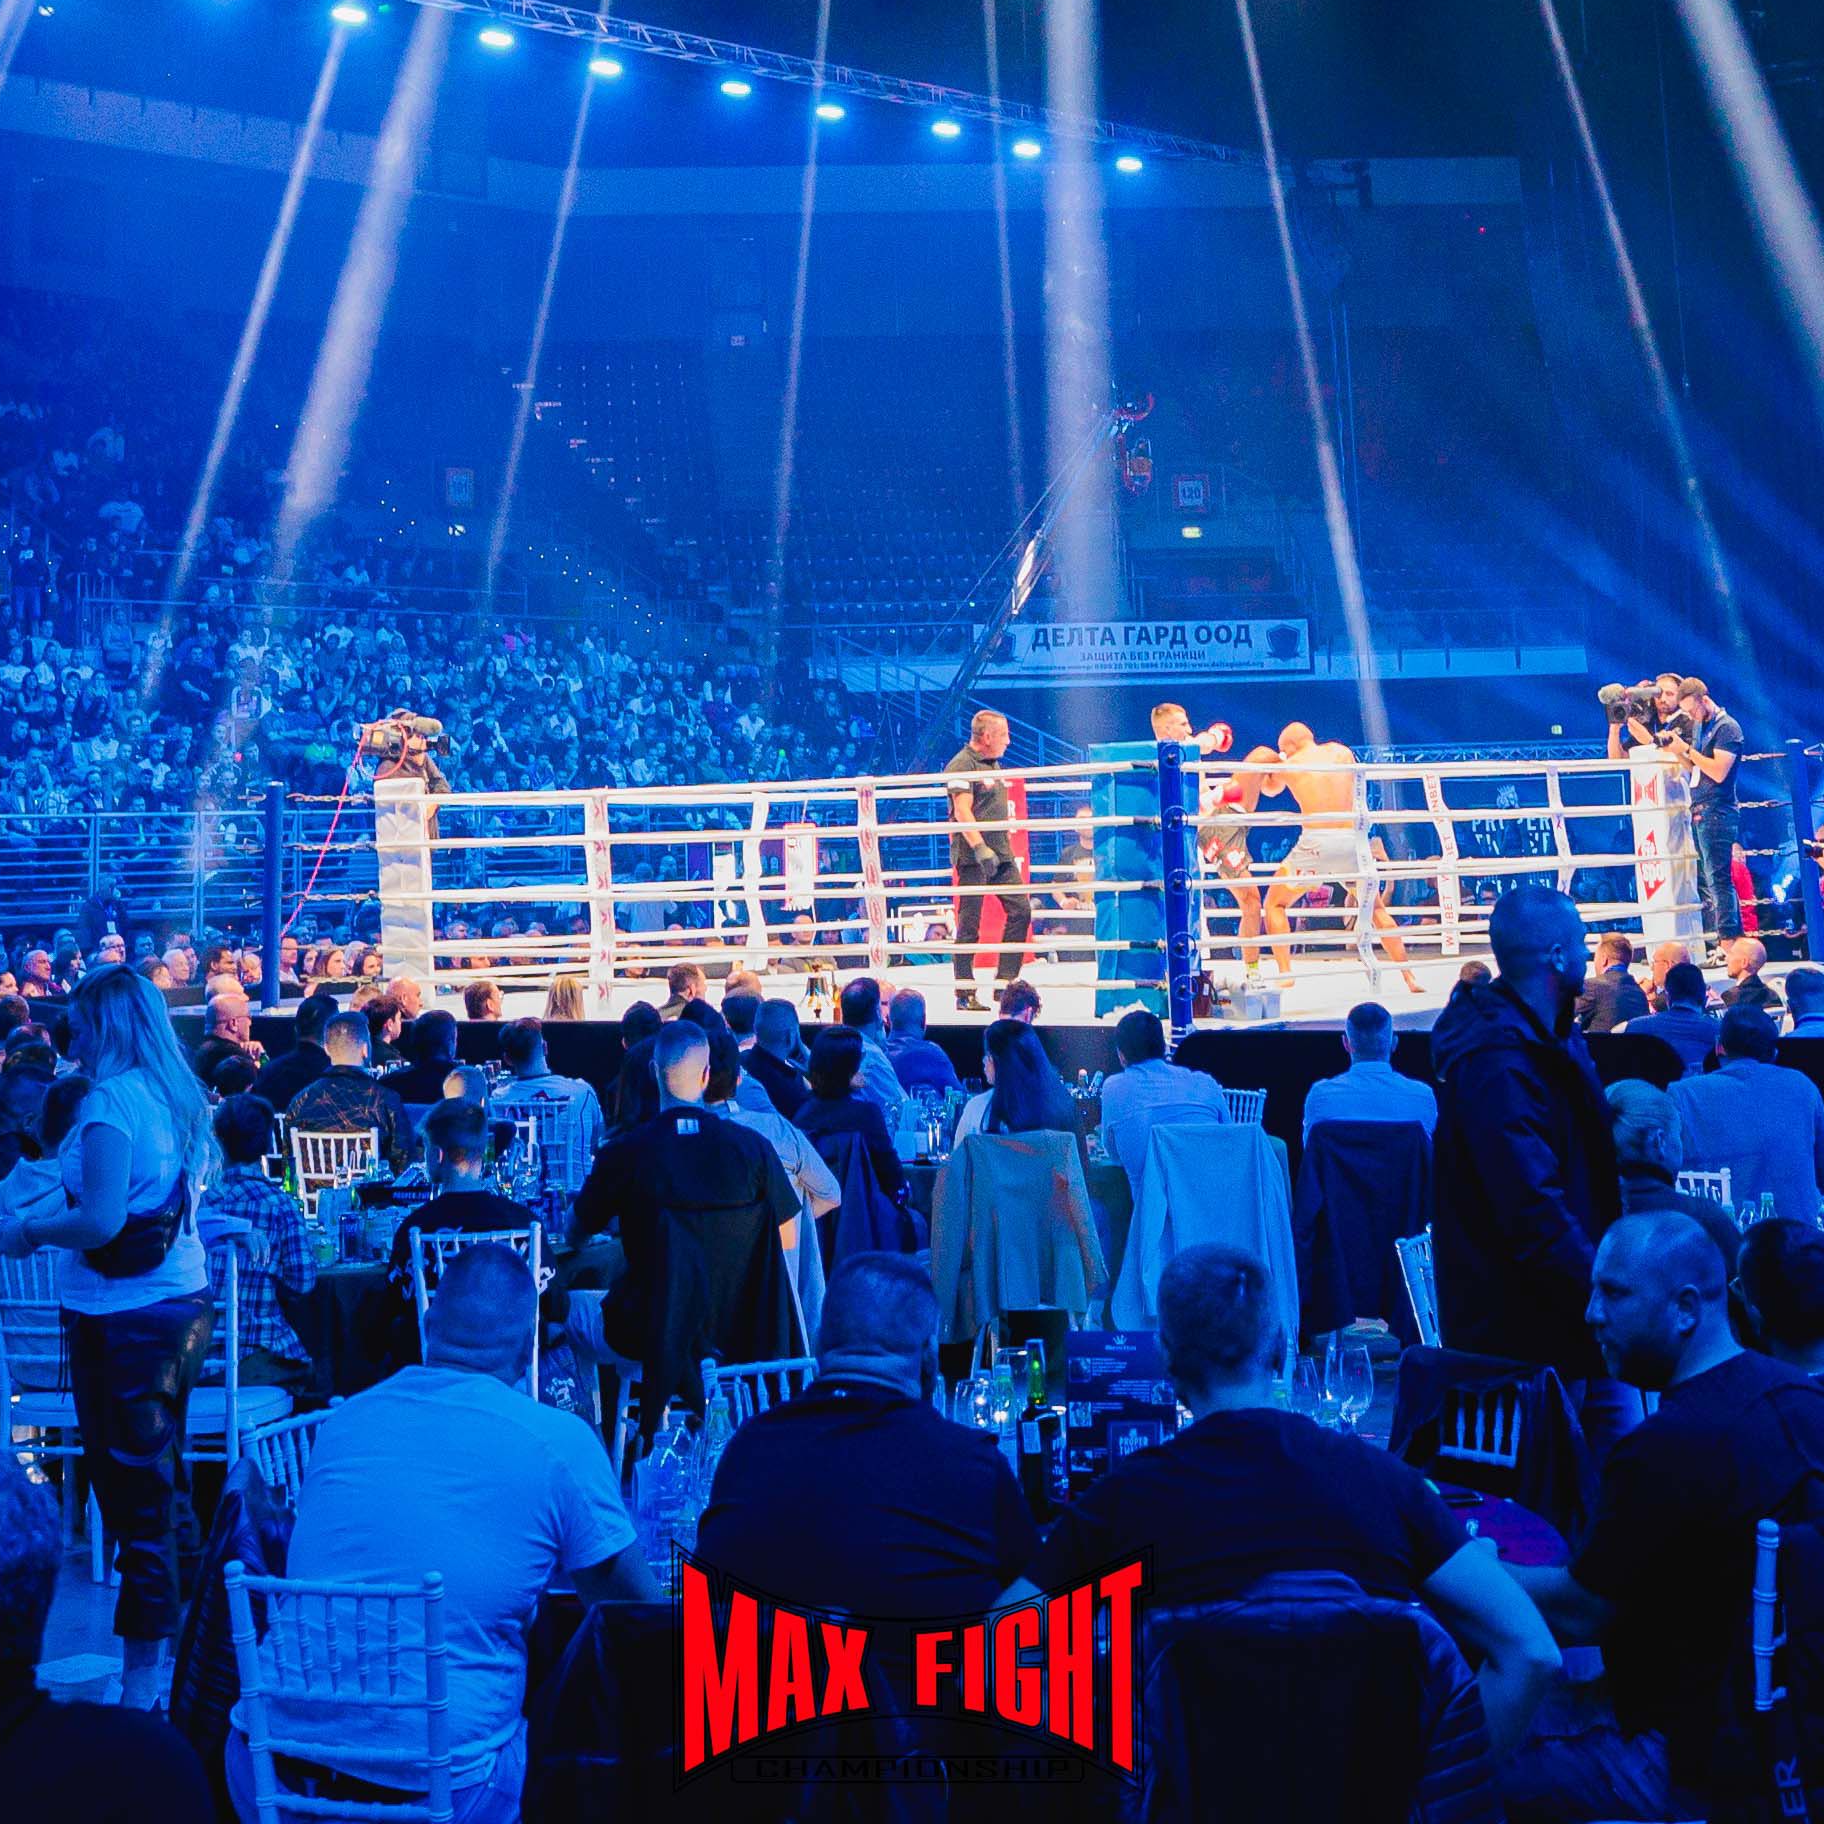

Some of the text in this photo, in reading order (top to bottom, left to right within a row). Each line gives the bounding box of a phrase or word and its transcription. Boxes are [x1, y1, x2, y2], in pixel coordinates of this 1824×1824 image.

[1032, 623, 1253, 652] ДЕЛТА ГАРД ООД
[1080, 650, 1206, 663] ЗАЩИТА БЕЗ ГРАНИЦИ
